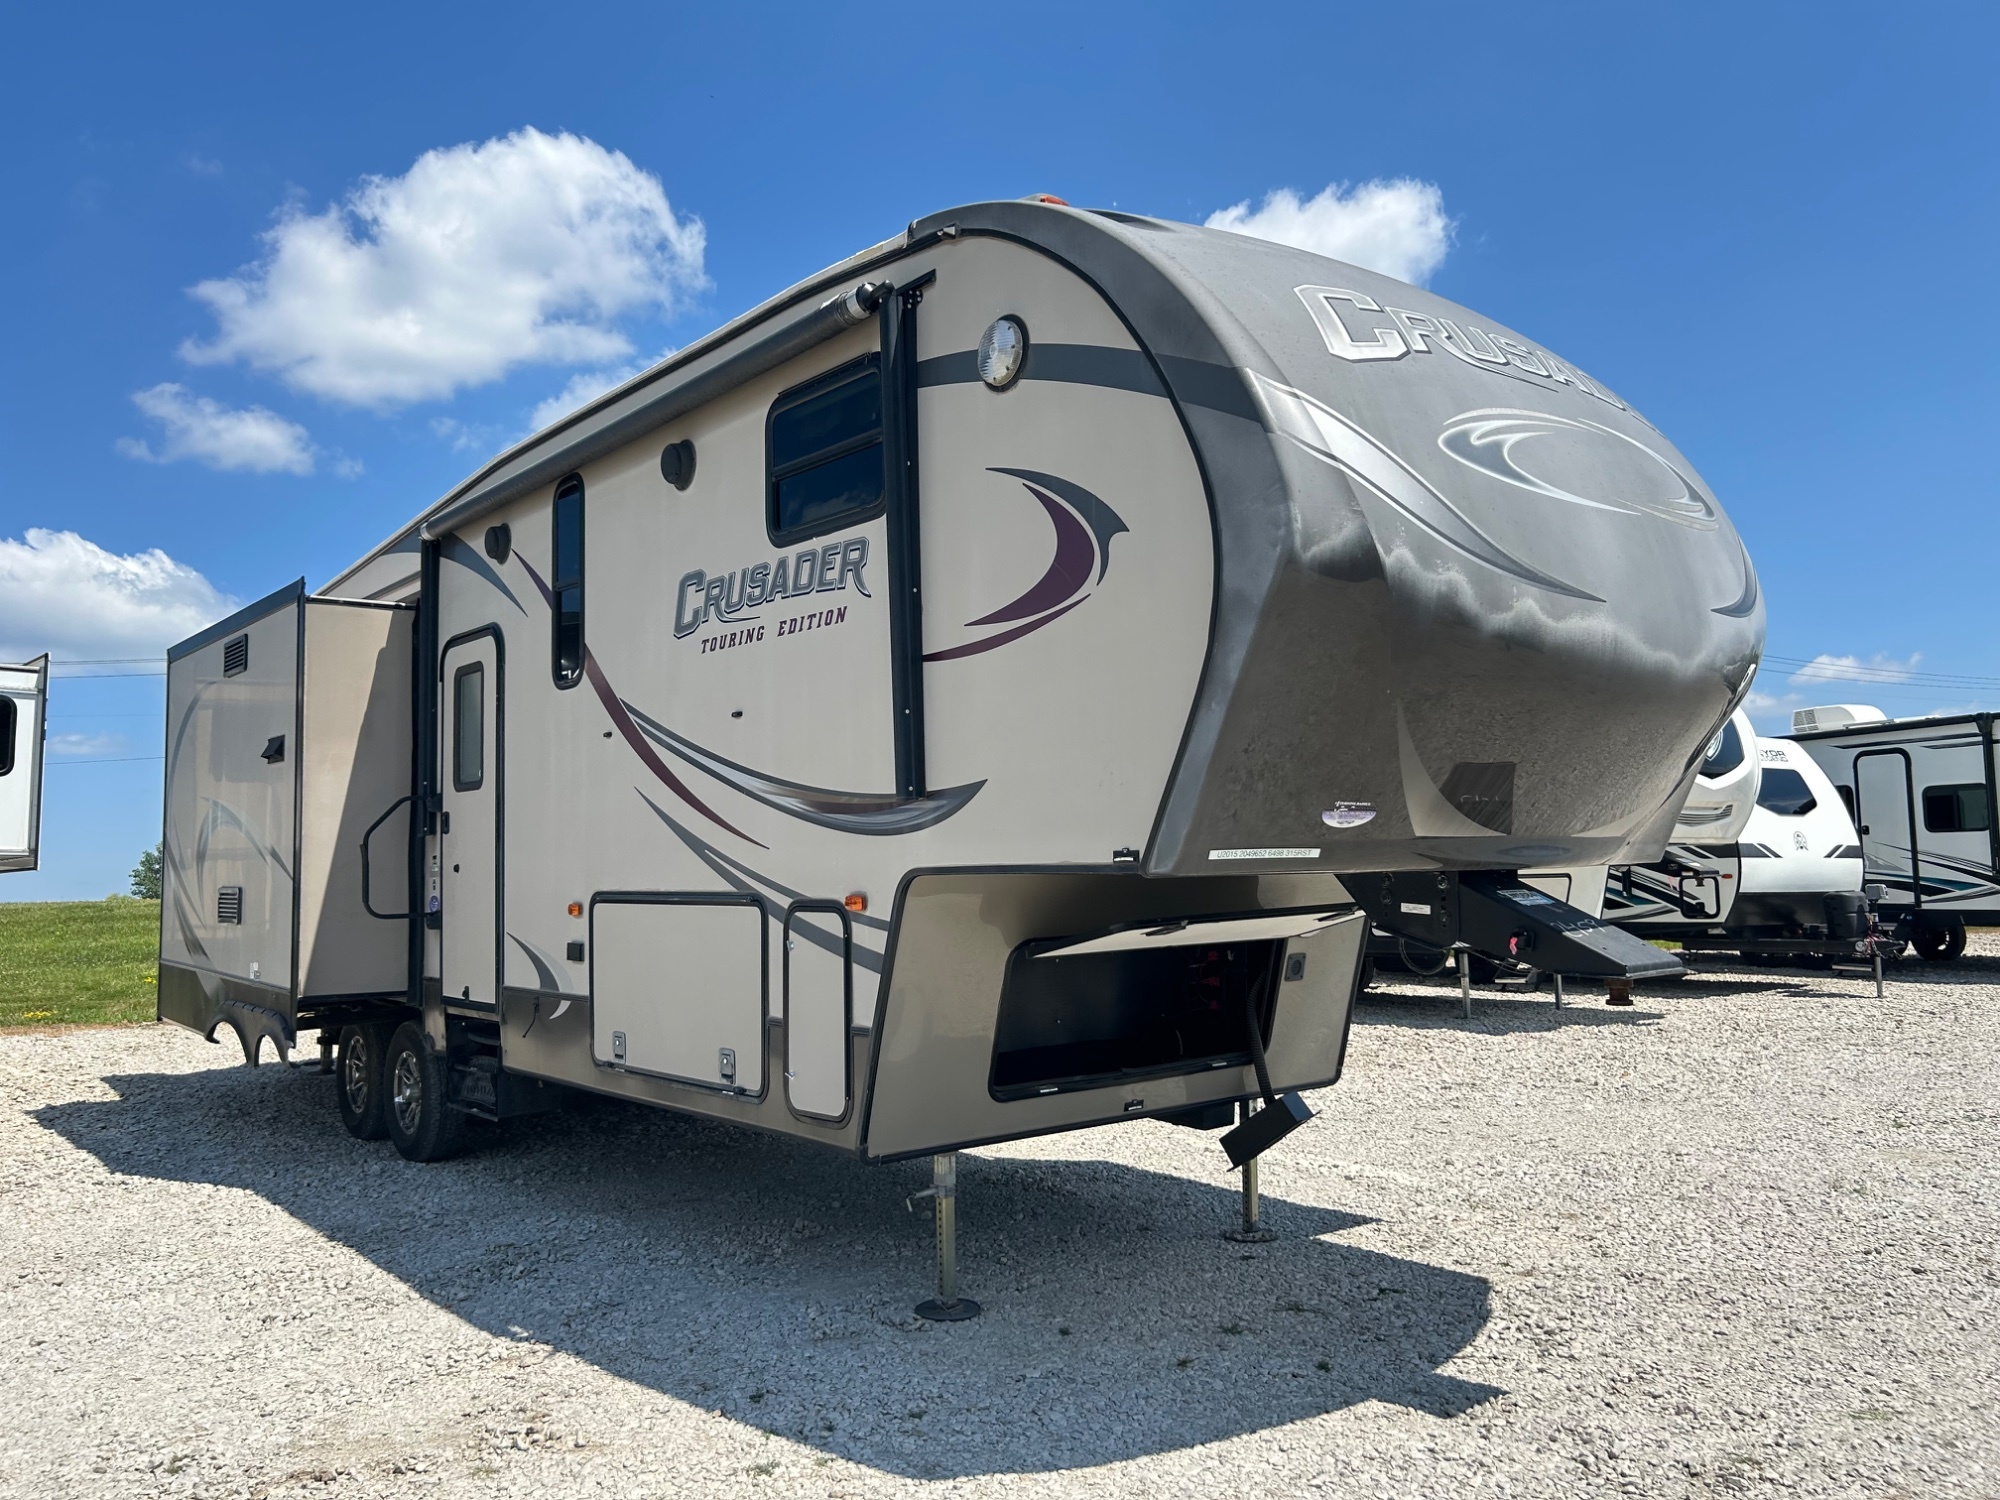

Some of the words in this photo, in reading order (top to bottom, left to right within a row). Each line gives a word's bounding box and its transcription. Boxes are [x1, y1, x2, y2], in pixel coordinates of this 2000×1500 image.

[1293, 284, 1667, 440] CRUSAD
[673, 536, 871, 640] CRUSADER
[701, 625, 765, 654] TOURING
[777, 605, 848, 638] EDITION
